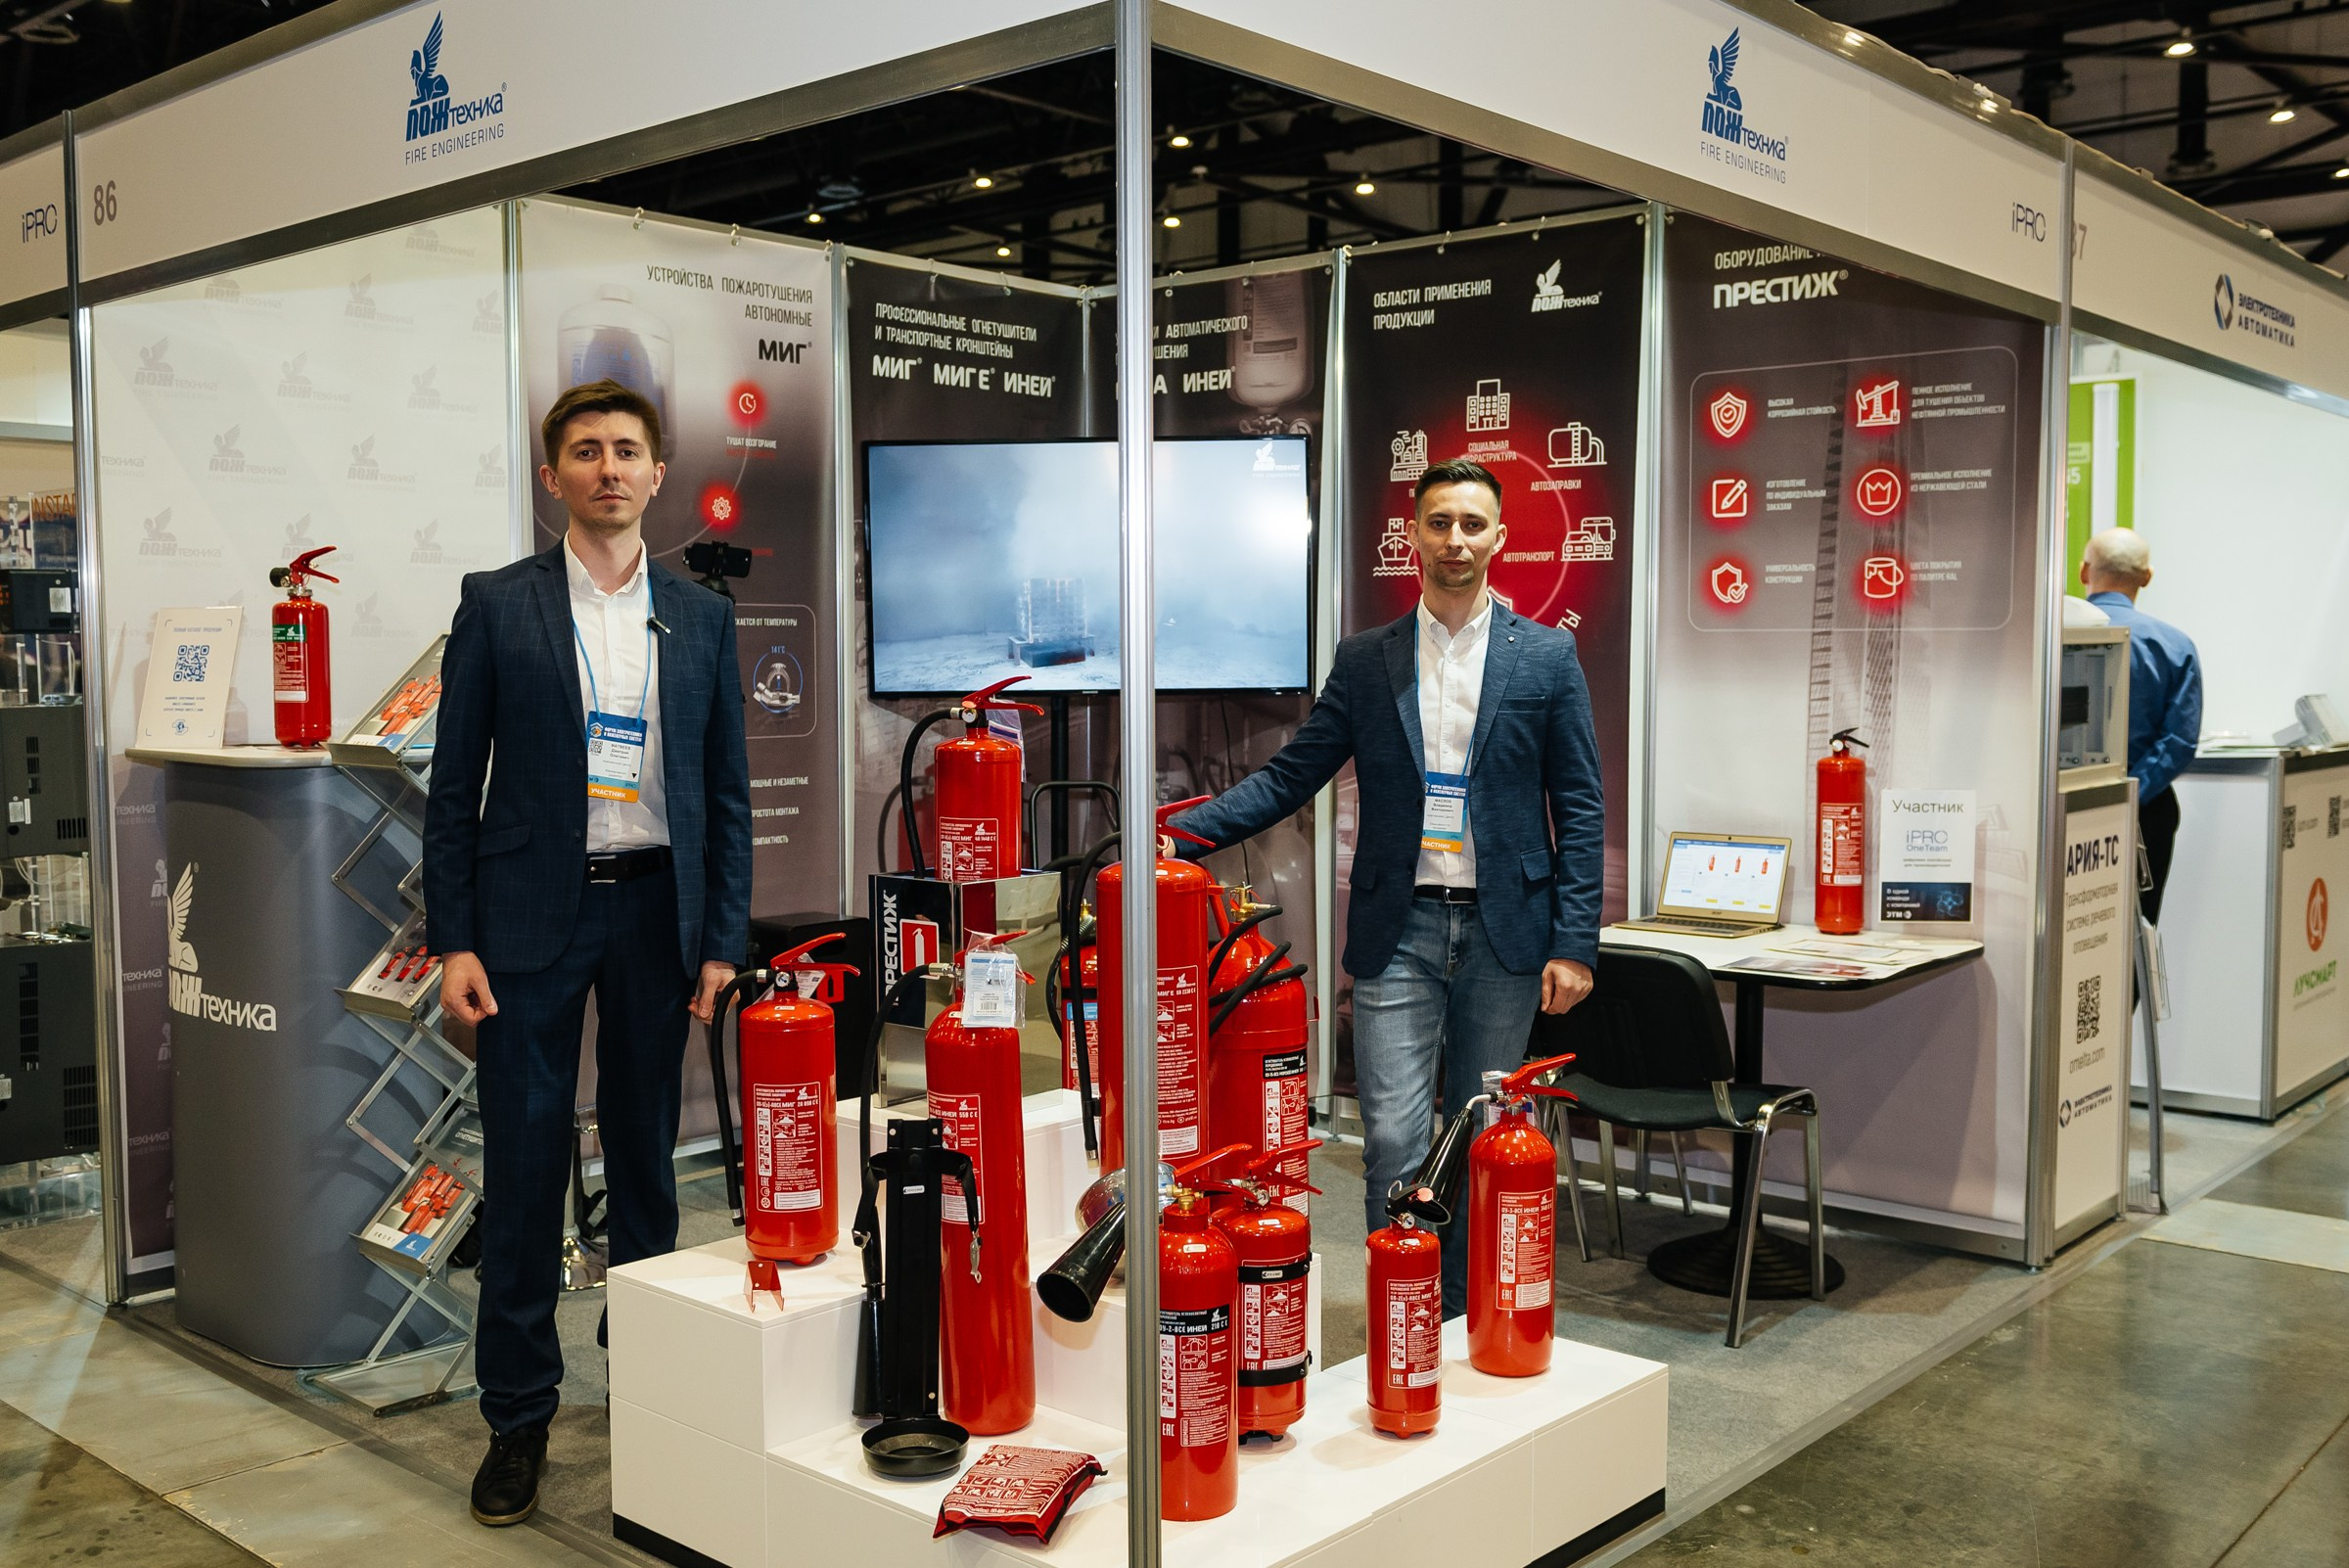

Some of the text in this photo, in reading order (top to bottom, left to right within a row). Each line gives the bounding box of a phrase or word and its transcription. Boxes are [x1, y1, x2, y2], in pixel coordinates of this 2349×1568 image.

[405, 122, 504, 165] FIRE ENGINEERING
[1700, 141, 1786, 184] FIRE ENGINEERING
[94, 180, 117, 226] 86
[22, 204, 58, 243] iPRO
[2011, 202, 2047, 243] iPRO
[647, 265, 813, 304] УСТРОЙСТВА ПОЖАРОТУШЕНИЯ
[1373, 279, 1492, 308] ОБЛАСТИ ПРИМЕНЕНИЯ
[1713, 270, 1839, 309] ПРЕСТИЖ
[745, 304, 813, 327] АВТОНОМНЫЕ
[875, 302, 1037, 342] ПРОФЕССИОНАЛЬНЫЕ ОГНЕТУШИТЕЛИ
[1165, 315, 1248, 339] АВТОМАТИЧЕСКОГО
[1373, 309, 1435, 330] ПРОДУКЦИИ
[875, 325, 1014, 358] И ТРАНСПОРТНЫЕ КРОНШТЕЙНЫ
[2237, 314, 2295, 347] АВТОМАТИКА
[759, 339, 807, 364] МИГ
[872, 354, 917, 380] МИГ
[1003, 371, 1052, 397] ИНЕЙ
[1182, 369, 1232, 393] ИНЕЙ
[1468, 439, 1509, 452] СОЦИАЛЬНАЯ
[1530, 480, 1582, 491] АВТОЗАПРАВКИ
[1502, 551, 1555, 562] АВТОТРАНСПОРТ
[764, 618, 798, 626] ТЕМПЕРАТУРЫ
[590, 788, 627, 799] УЧАСТНИК
[775, 807, 800, 815] МОНТАЖА
[1892, 800, 1964, 813] Участник
[1907, 830, 1949, 844] iPRO
[1907, 844, 1949, 853] OneTeam
[2066, 835, 2119, 877] АРИЯ-ТС
[1186, 1324, 1208, 1333] ИНЕЙ
